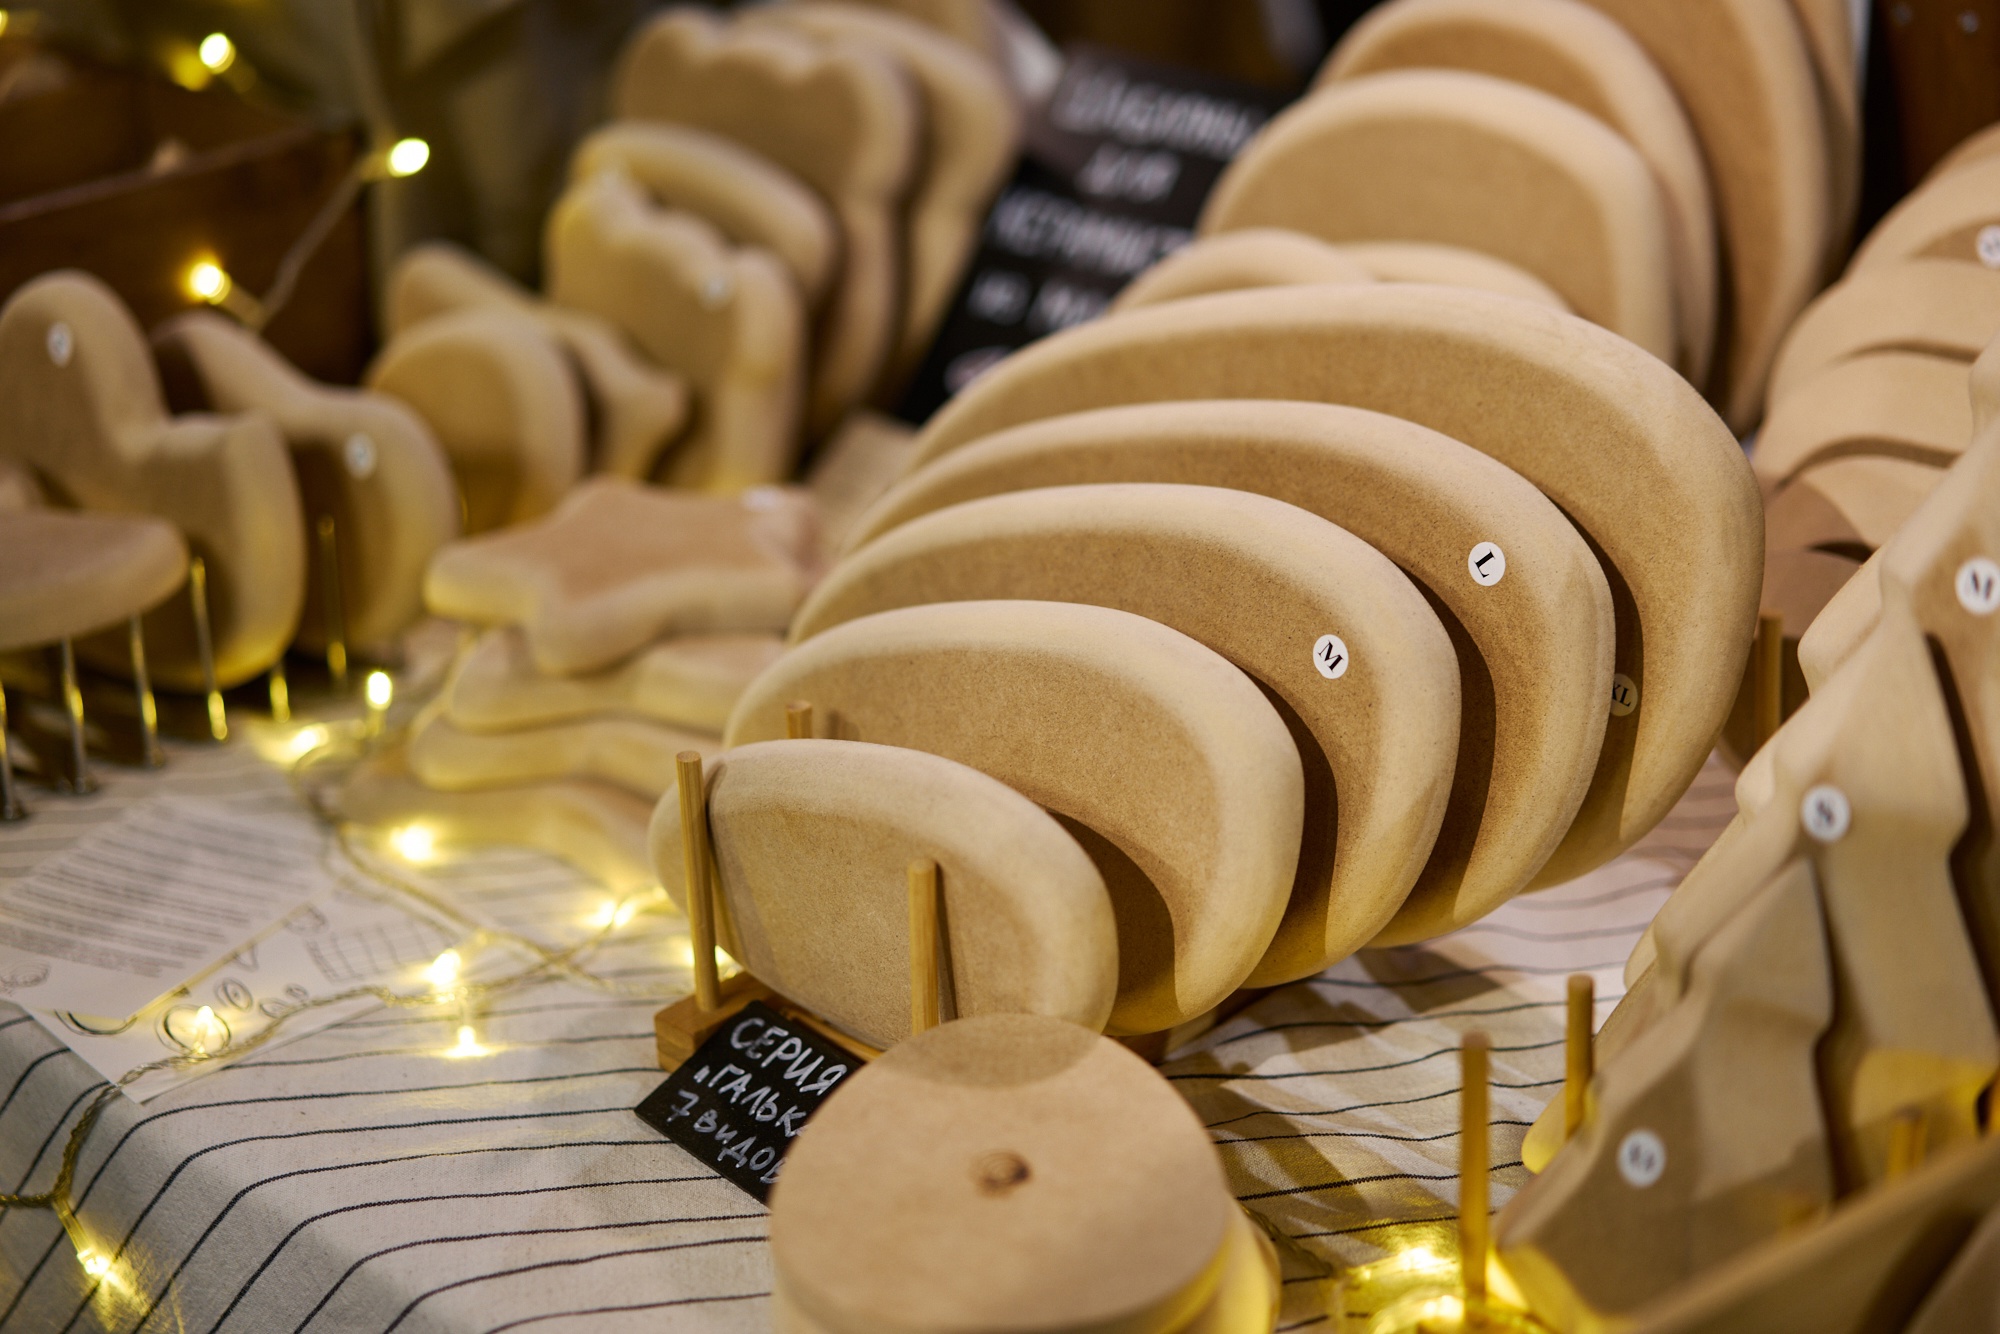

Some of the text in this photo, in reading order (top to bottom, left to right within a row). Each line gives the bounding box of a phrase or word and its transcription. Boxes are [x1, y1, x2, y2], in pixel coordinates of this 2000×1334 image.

[1474, 549, 1496, 578] L
[1317, 640, 1344, 673] M
[730, 1017, 847, 1096] СЕРИЯ
[666, 1088, 699, 1123] 7
